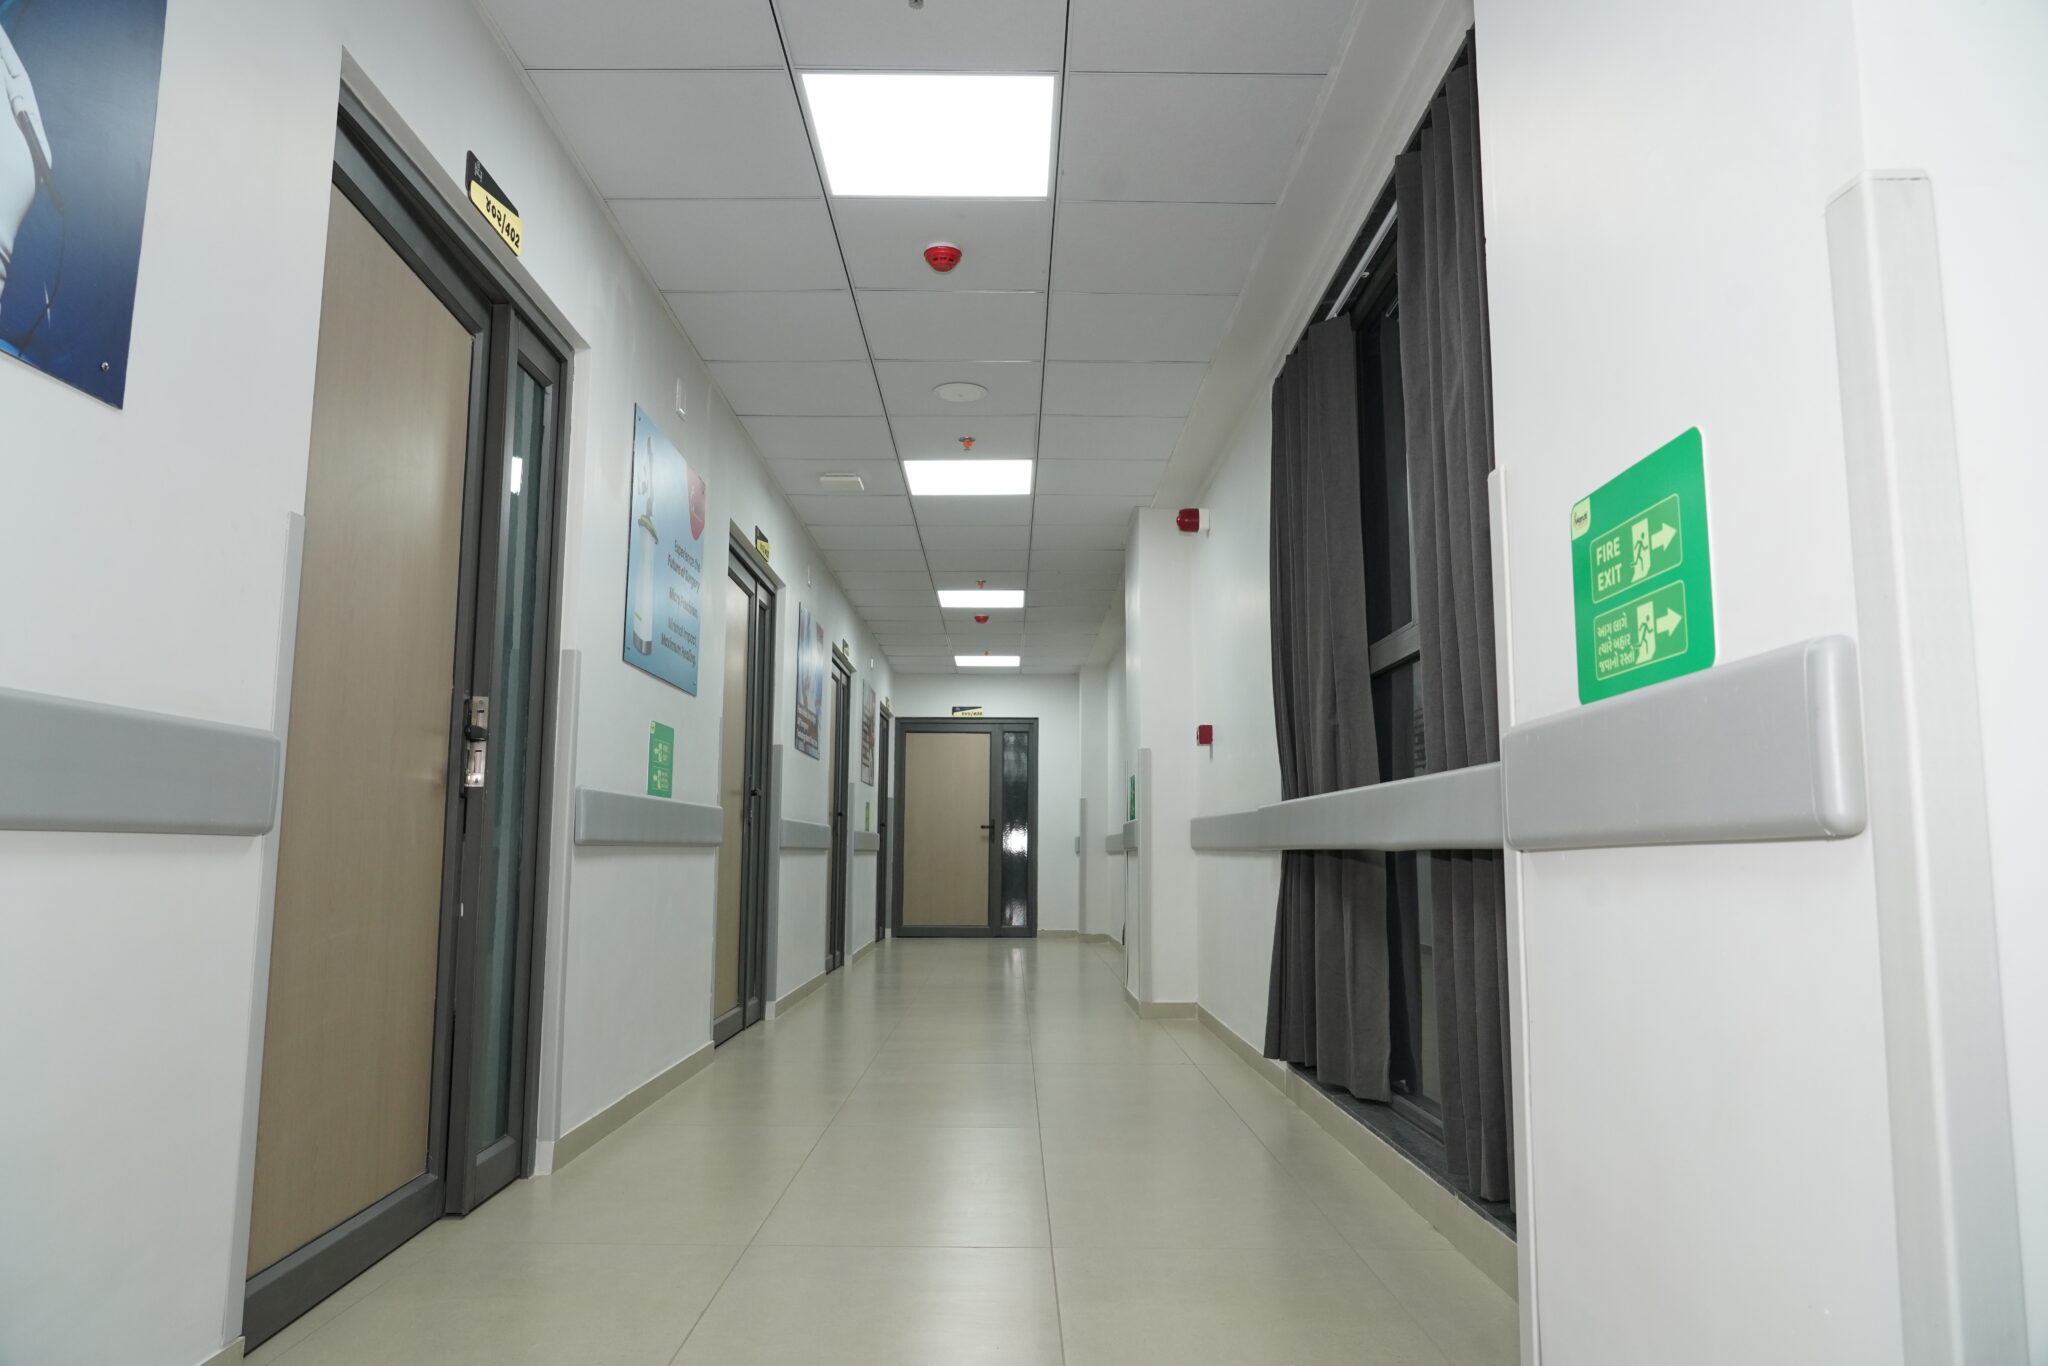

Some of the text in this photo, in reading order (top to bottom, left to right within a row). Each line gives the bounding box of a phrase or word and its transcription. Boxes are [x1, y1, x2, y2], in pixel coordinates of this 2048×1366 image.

[1596, 536, 1621, 566] FIRE
[685, 569, 700, 592] Surgery
[1598, 563, 1622, 592] EXIT
[1597, 612, 1628, 637] આગ લાગે
